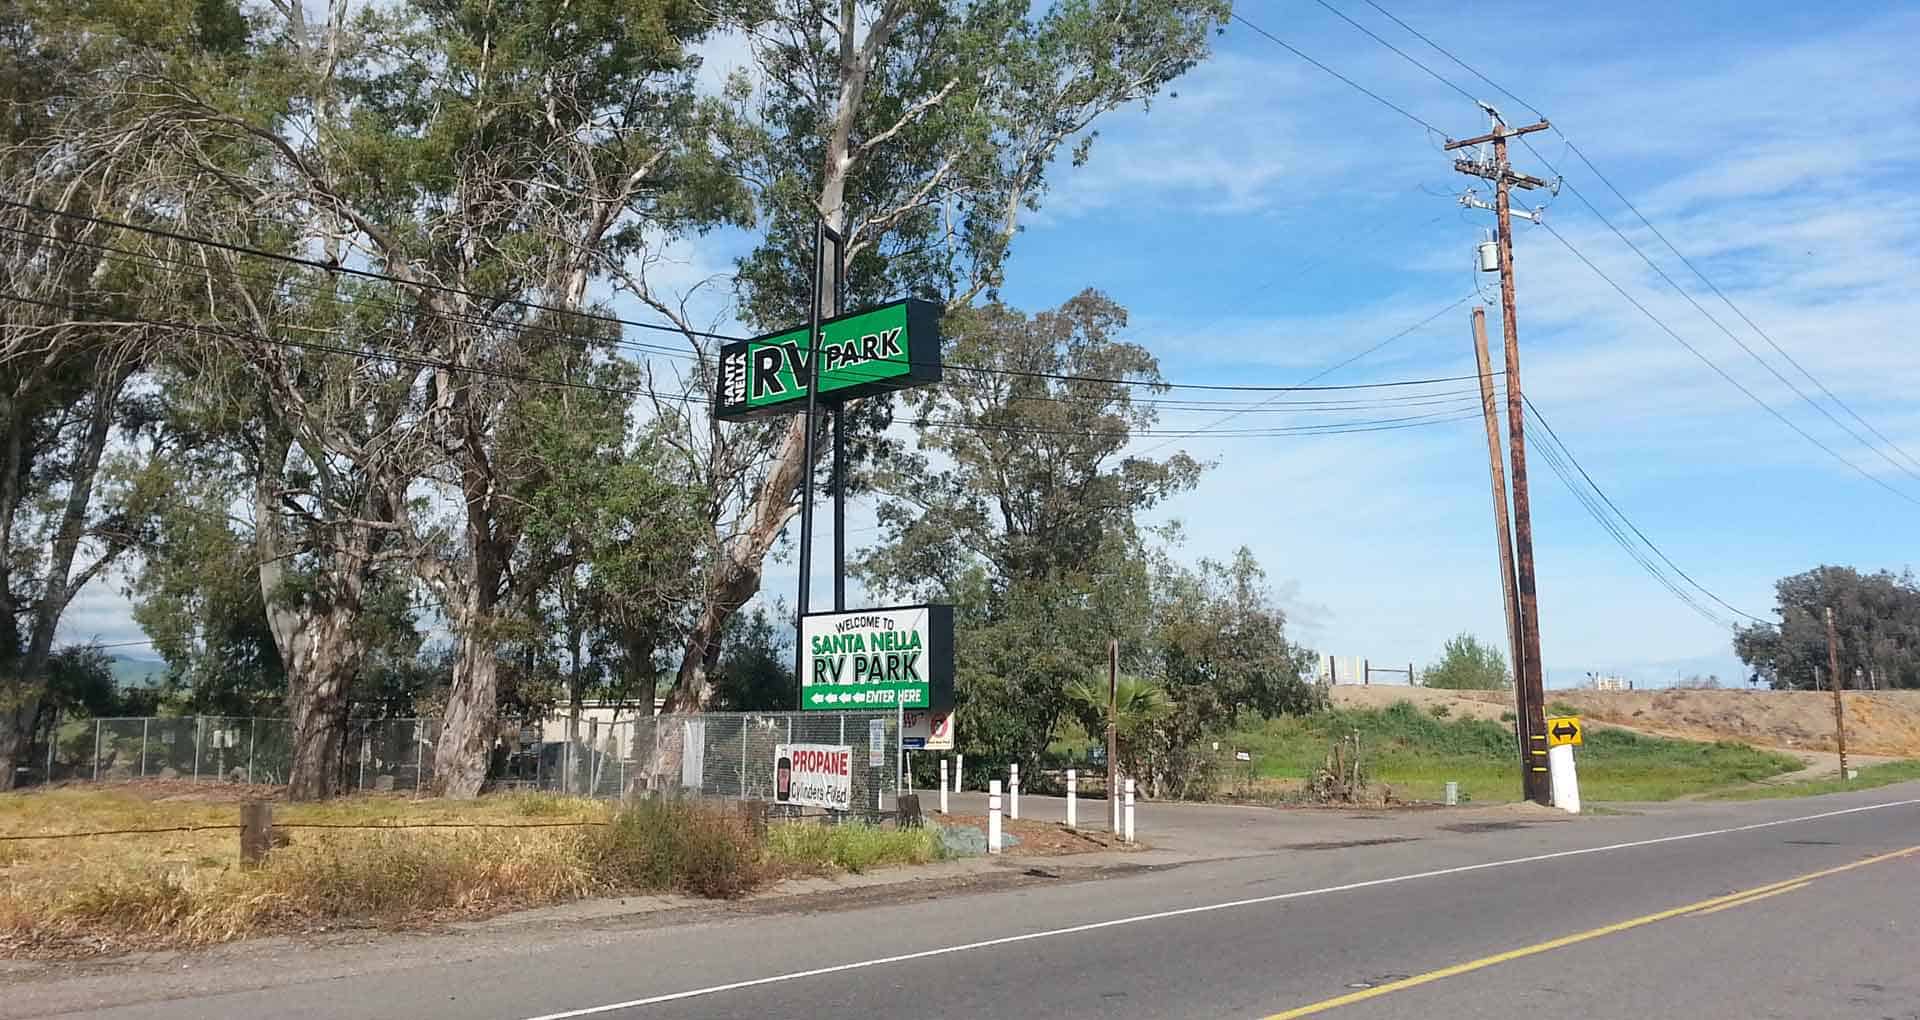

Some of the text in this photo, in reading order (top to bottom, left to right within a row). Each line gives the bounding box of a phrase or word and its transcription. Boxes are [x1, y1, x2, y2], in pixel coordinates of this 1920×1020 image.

[733, 352, 746, 403] NELLA
[751, 327, 903, 400] RV PARK
[723, 353, 736, 407] SANTA
[835, 616, 895, 633] WELCOME TO
[811, 629, 922, 655] SANTA NELLA
[812, 651, 922, 684] RV PARK
[866, 689, 922, 703] ENTER HERE
[792, 750, 849, 776] PROPANE
